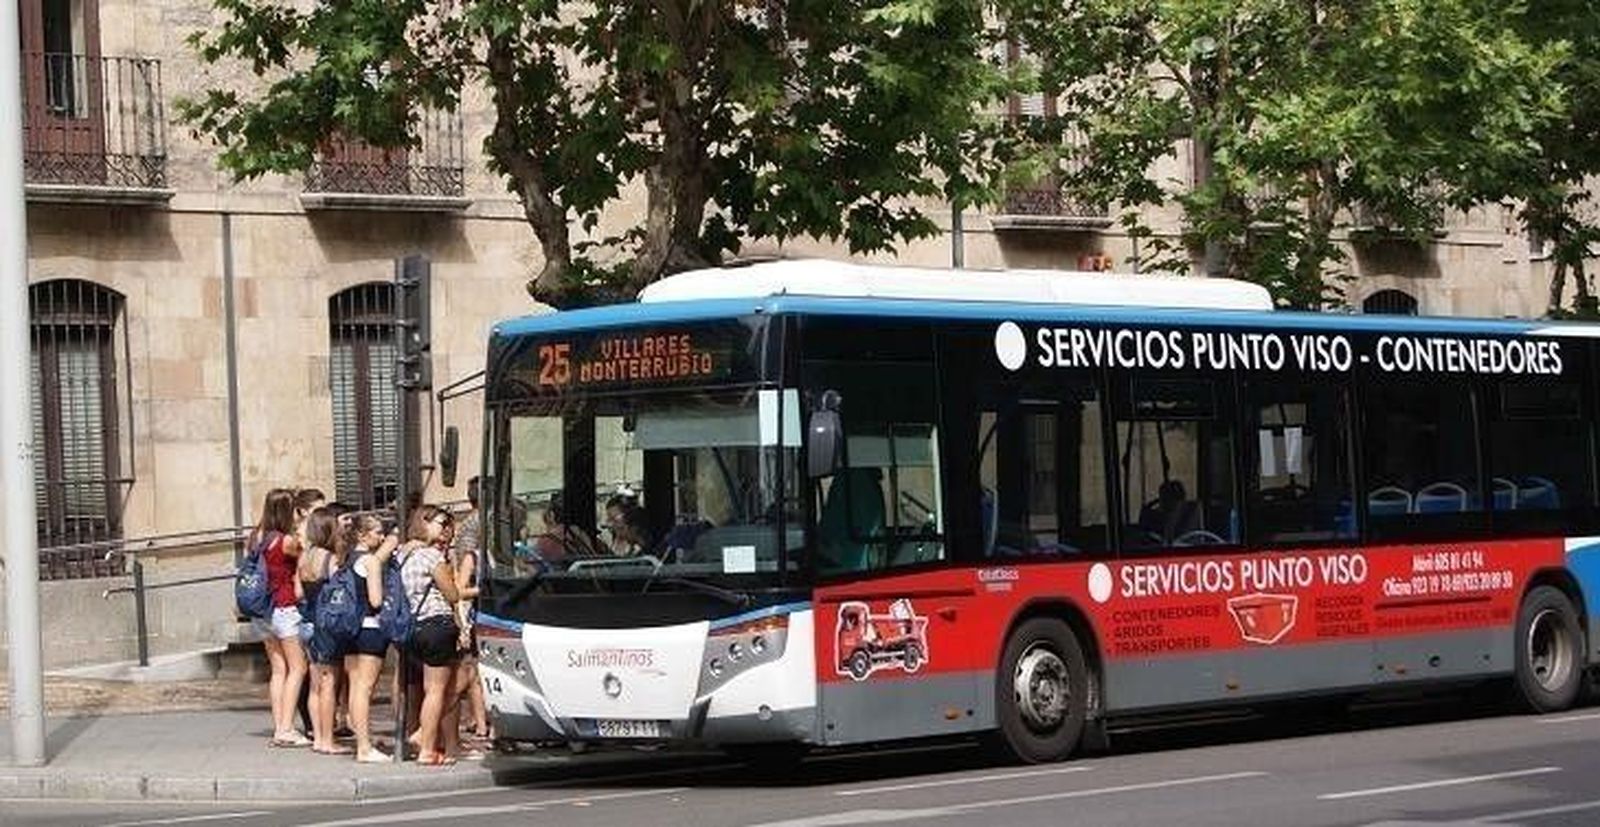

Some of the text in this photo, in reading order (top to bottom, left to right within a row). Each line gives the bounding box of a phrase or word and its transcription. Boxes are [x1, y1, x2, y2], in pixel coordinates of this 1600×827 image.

[601, 334, 691, 359] VILLARES
[1037, 327, 1185, 369] SERVICIOS
[1192, 332, 1285, 370] PUNTO
[1290, 334, 1351, 371] VISO
[1377, 336, 1562, 374] CONTENEDORES
[539, 344, 571, 385] 25
[580, 353, 712, 382] MONTERRUBIO
[1121, 554, 1368, 597] SERVICIOS PUNTO VISO
[1112, 604, 1220, 623] CONTENEDORES
[1113, 636, 1211, 653] TRANSPORTES
